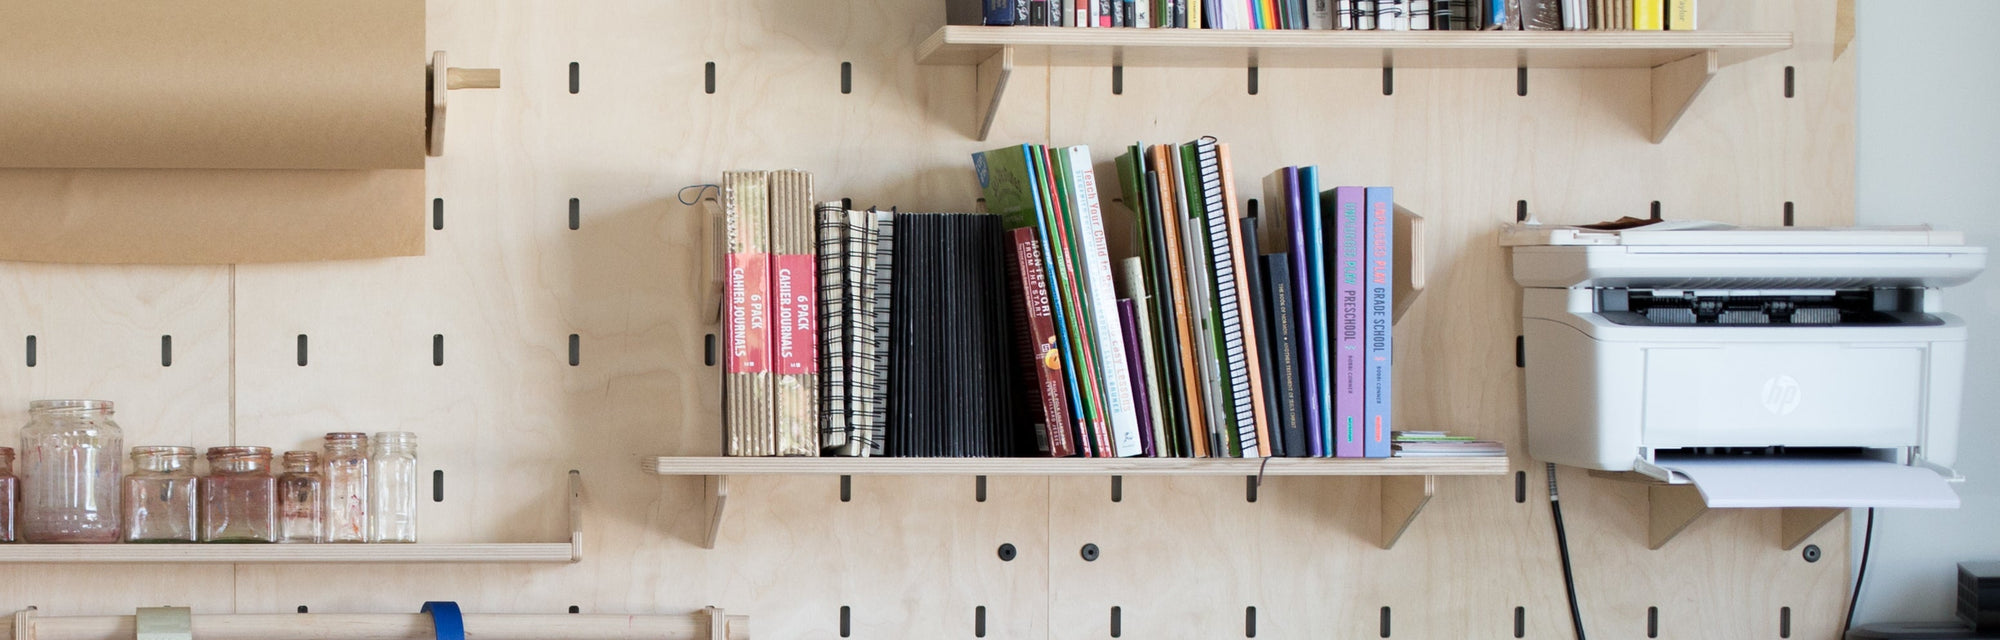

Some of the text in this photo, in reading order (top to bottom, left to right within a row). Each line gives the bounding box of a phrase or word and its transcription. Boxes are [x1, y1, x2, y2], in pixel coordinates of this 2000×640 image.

[1084, 169, 1095, 199] Teach
[1090, 203, 1100, 226] Your
[1094, 230, 1106, 257] Child
[1025, 241, 1033, 265] FROM
[1032, 289, 1041, 317] START
[1032, 239, 1050, 316] MONTESSORI
[1344, 261, 1356, 284] PLAY
[1373, 260, 1386, 283] PLAY
[733, 267, 746, 357] CAHIER JOURNALS
[751, 303, 762, 329] PACK
[780, 269, 792, 358] CAHIER JOURNALS
[1344, 290, 1356, 341] PRESCHOOL
[1373, 287, 1385, 316] GRADE
[798, 304, 809, 330] PACK
[1373, 319, 1385, 352] SCHOOL
